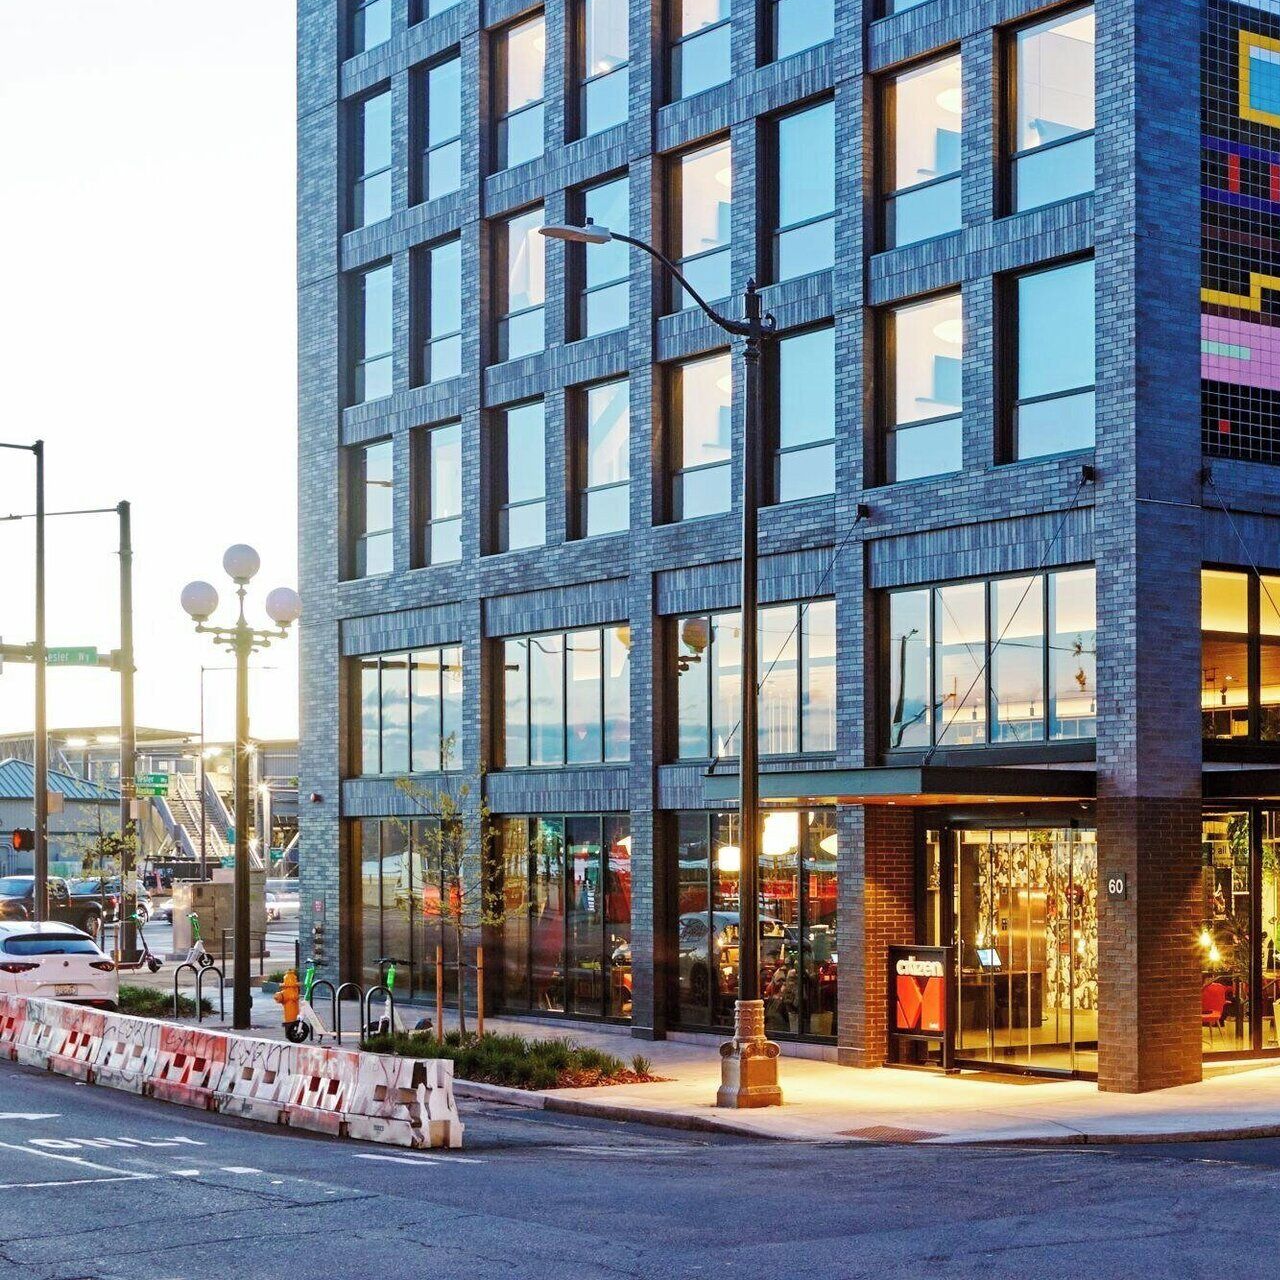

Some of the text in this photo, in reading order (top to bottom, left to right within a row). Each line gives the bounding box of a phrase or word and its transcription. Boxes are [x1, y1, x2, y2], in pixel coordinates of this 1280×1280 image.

[47, 652, 68, 662] esler
[1109, 879, 1123, 894] 60
[896, 955, 944, 977] citizen
[27, 1137, 207, 1149] ONLY
